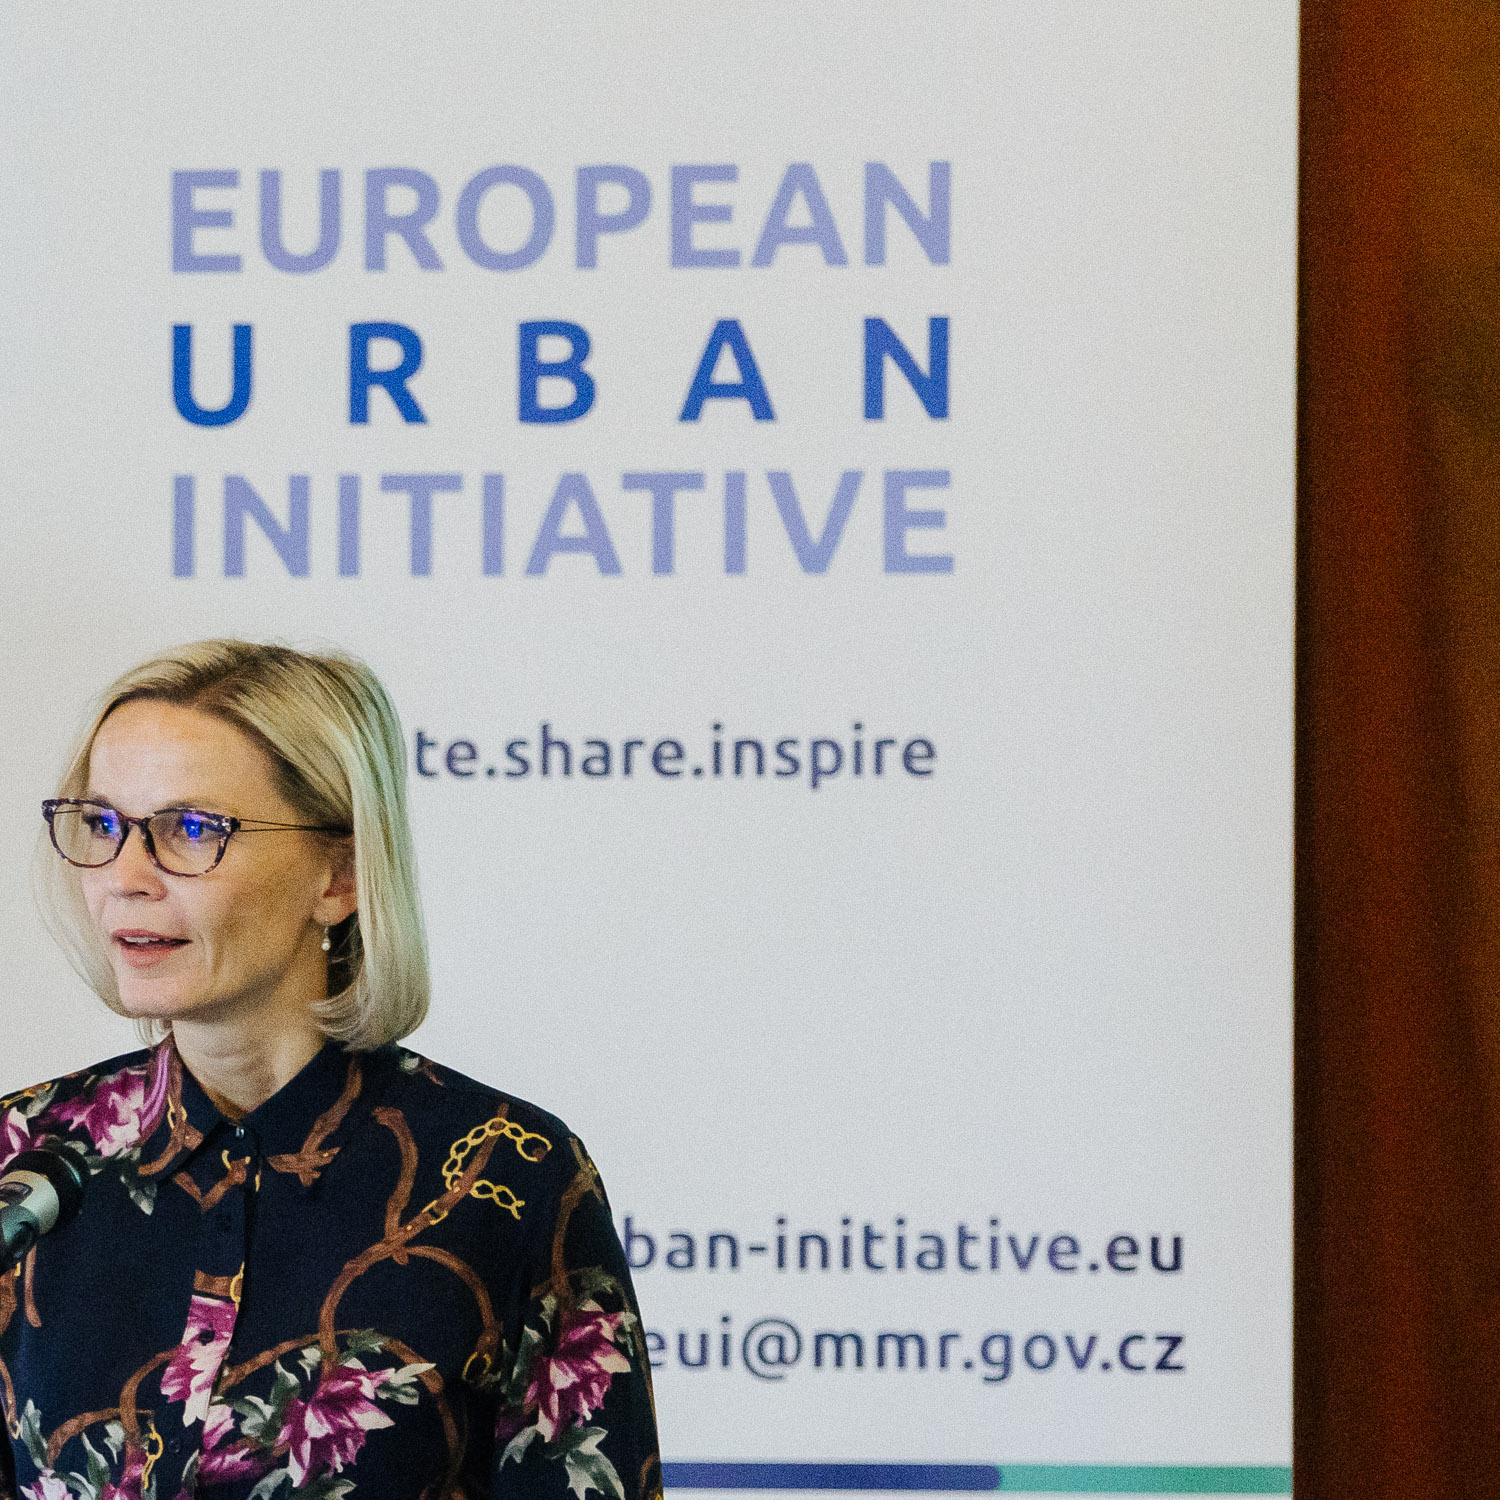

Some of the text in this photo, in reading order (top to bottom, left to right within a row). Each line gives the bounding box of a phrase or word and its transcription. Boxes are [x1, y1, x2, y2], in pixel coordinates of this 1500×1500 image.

[171, 161, 953, 275] EUROPEAN
[171, 316, 951, 428] URBAN
[172, 469, 955, 579] INITIATIVE
